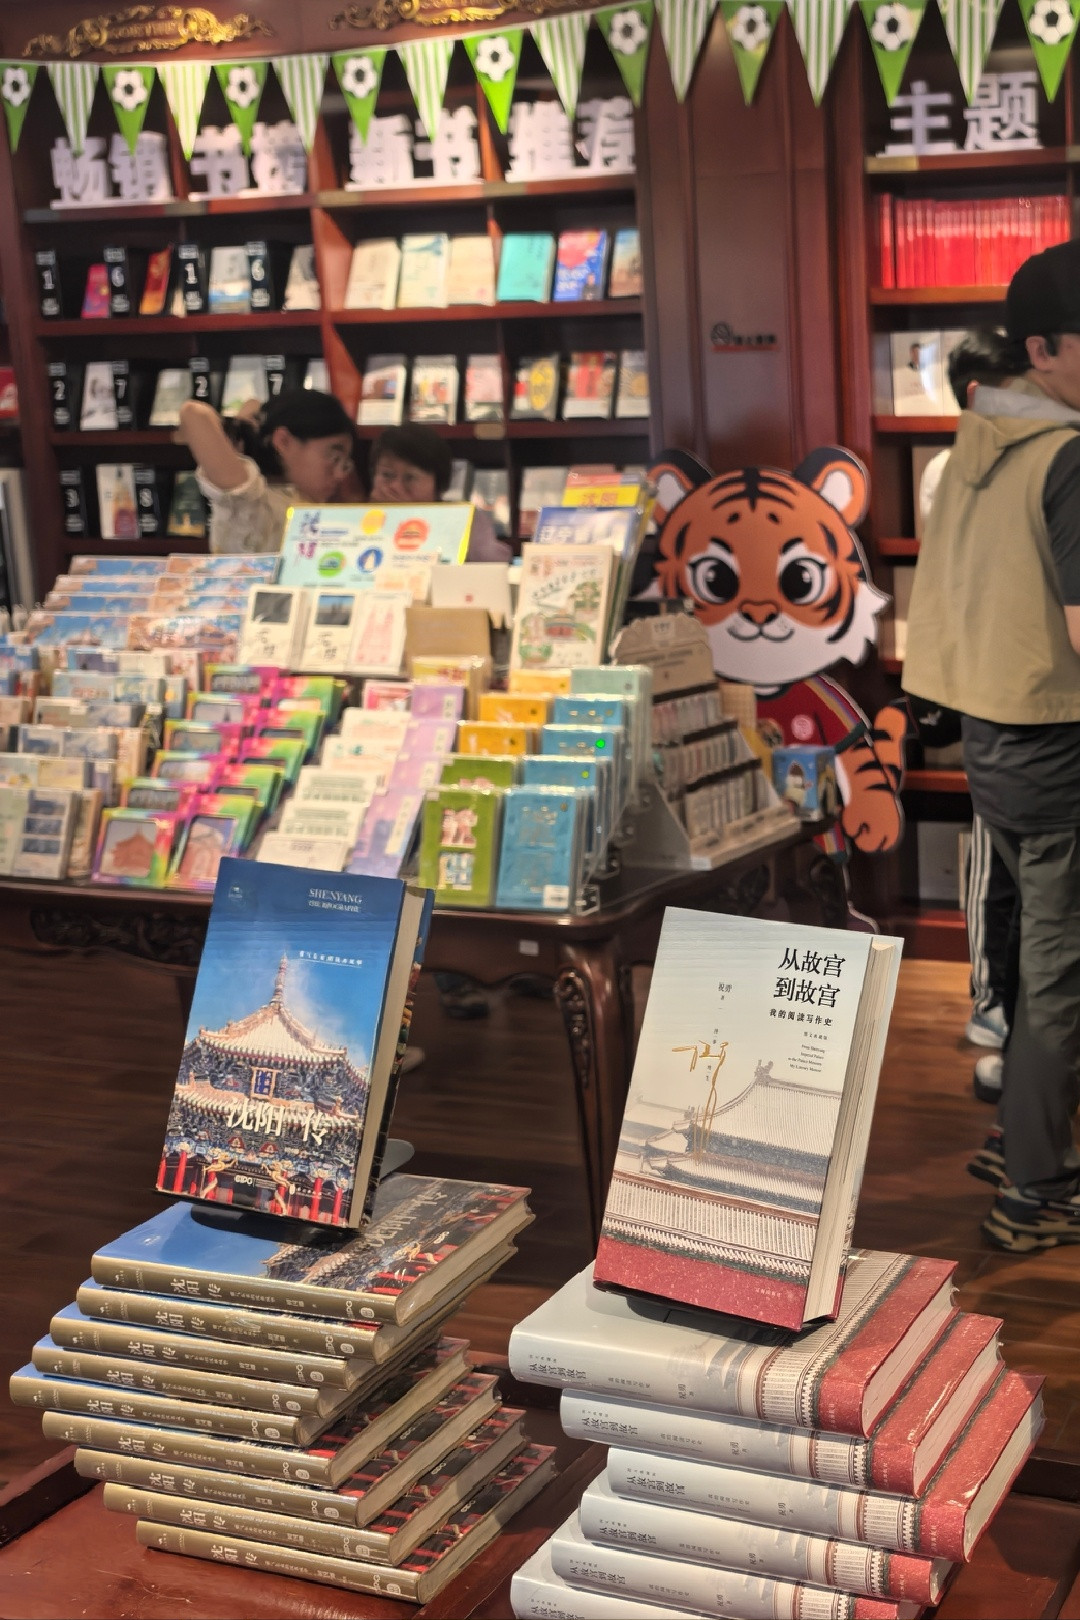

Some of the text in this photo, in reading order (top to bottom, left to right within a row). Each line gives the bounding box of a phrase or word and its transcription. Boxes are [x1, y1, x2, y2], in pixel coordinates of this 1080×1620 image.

[777, 947, 846, 978] 从故宫
[773, 976, 841, 1008] 到故宫
